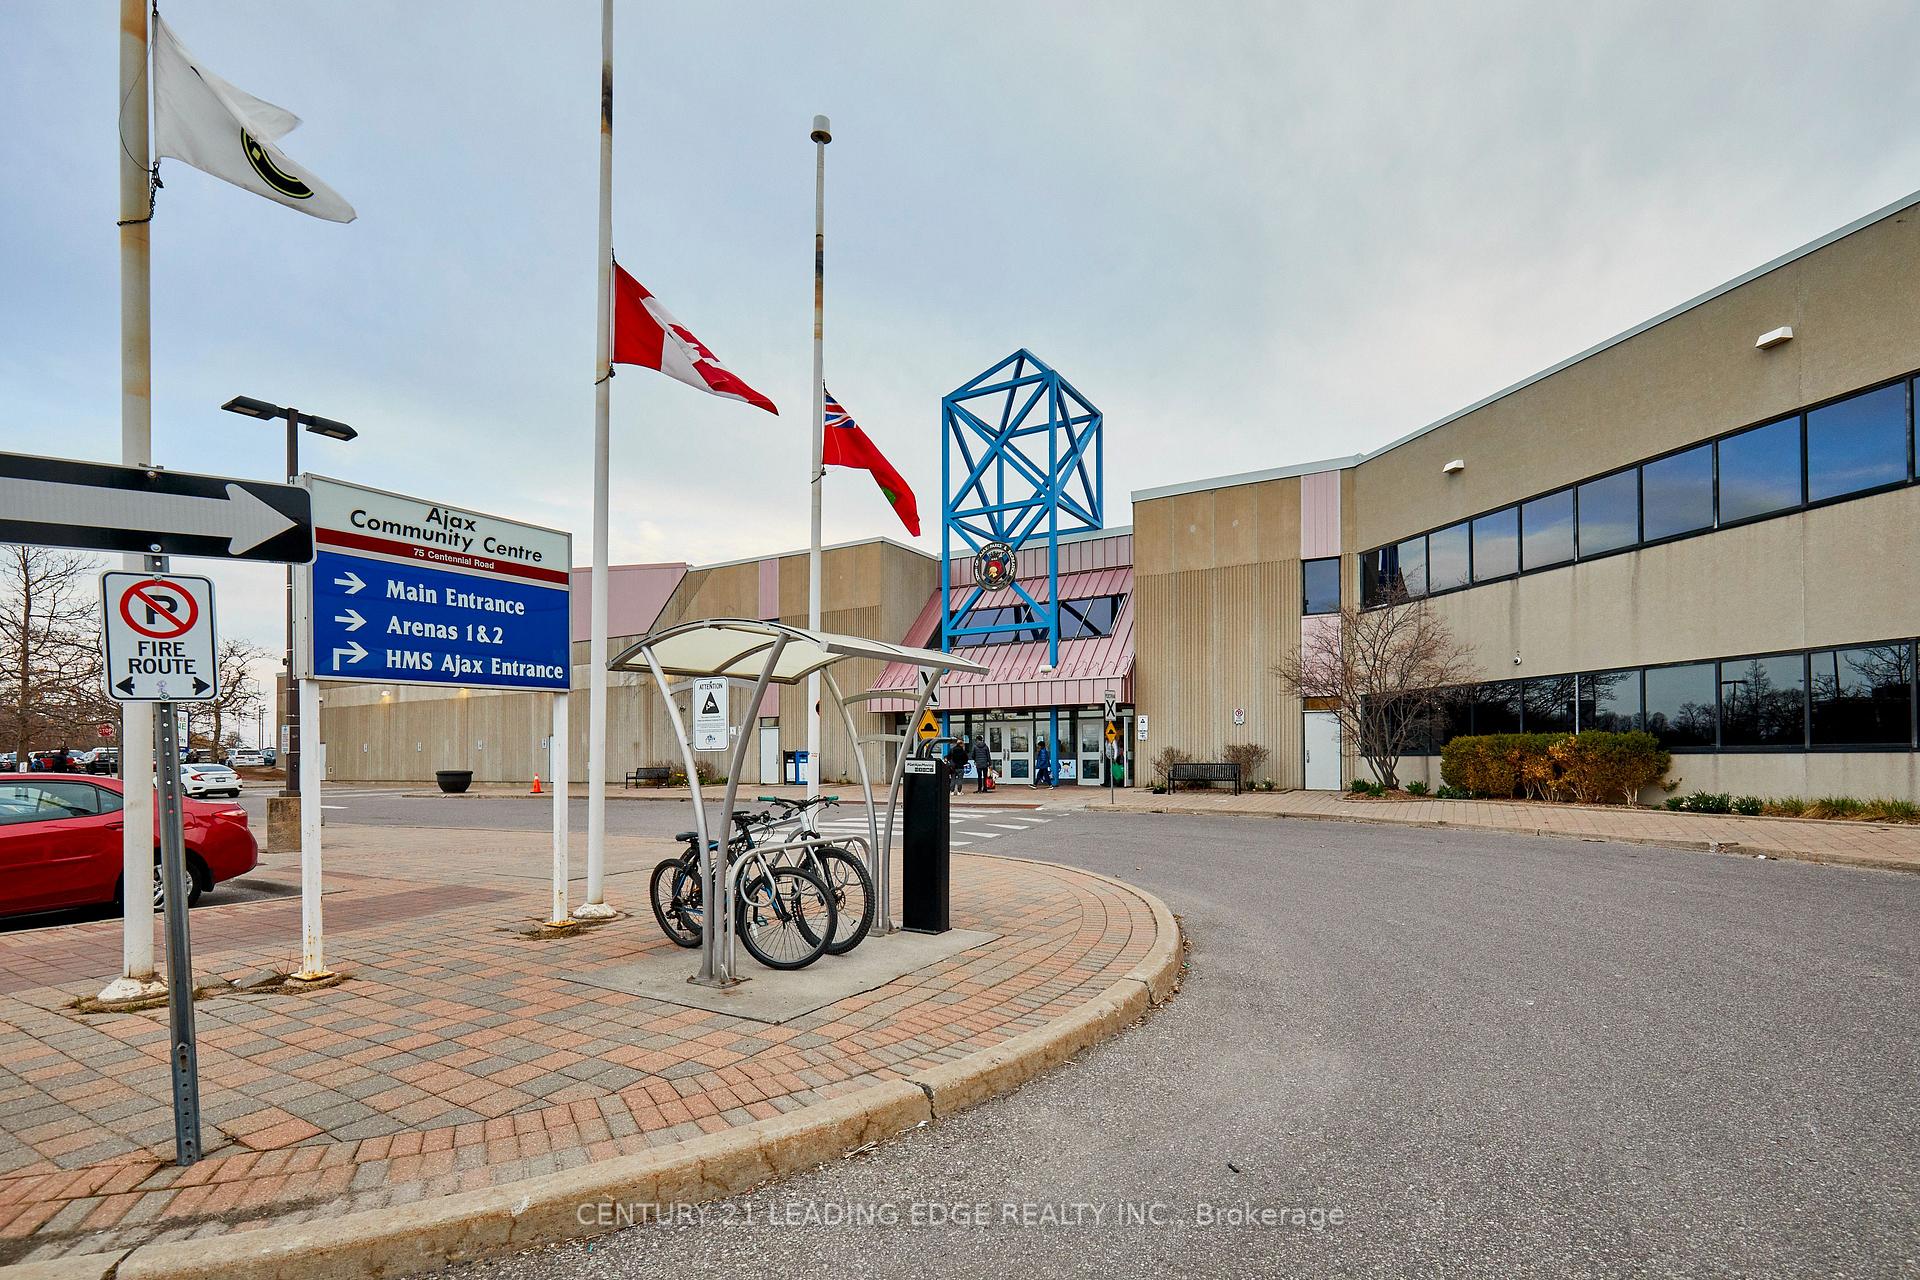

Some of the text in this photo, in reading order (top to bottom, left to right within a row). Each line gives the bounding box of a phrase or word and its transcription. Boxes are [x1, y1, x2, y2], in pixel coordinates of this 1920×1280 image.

[425, 507, 476, 532] Ajax
[350, 509, 542, 562] Community Centre
[413, 547, 495, 570] 75 Centennial Road
[386, 579, 525, 616] Main Entrance
[386, 615, 504, 645] Arenas 1&2
[137, 640, 186, 658] FIRE
[128, 658, 197, 675] ROUTE
[386, 649, 564, 679] HMS Ajax Entrance
